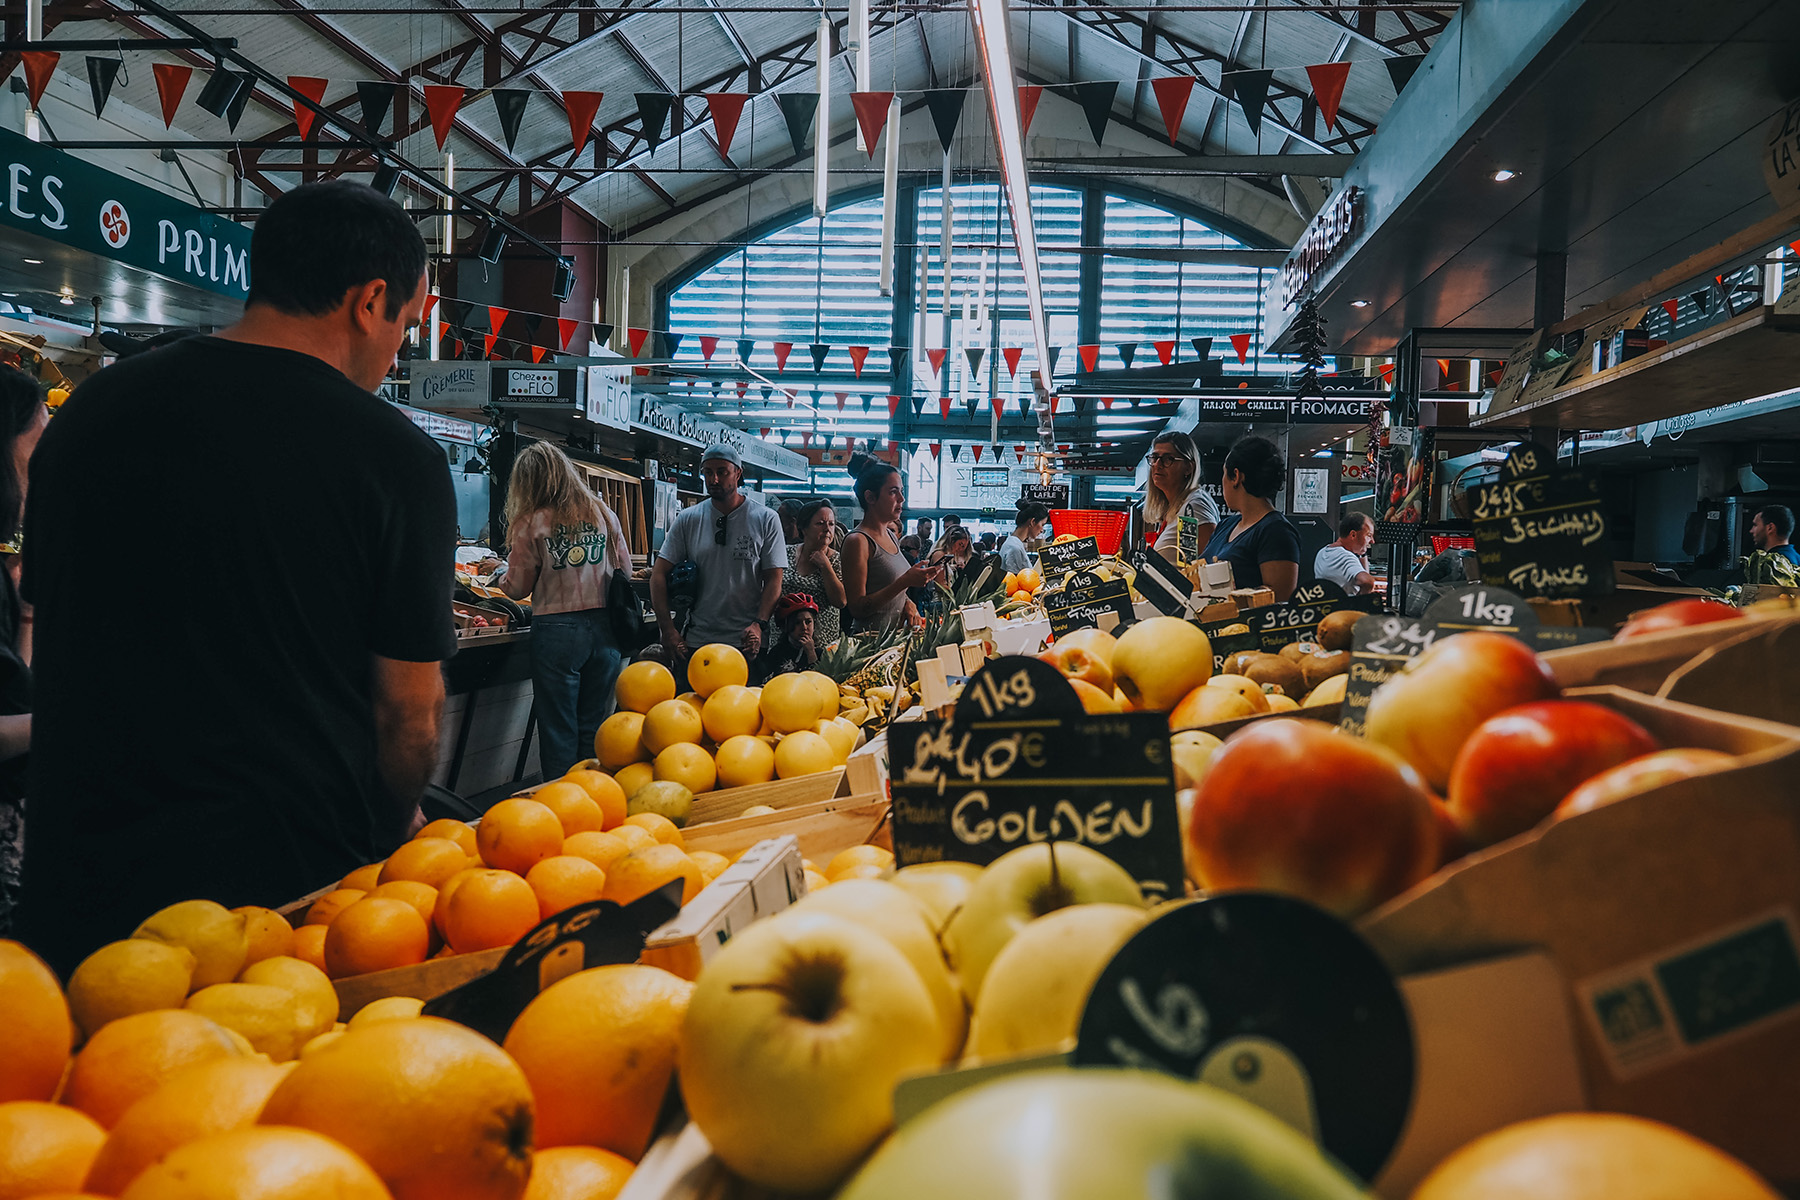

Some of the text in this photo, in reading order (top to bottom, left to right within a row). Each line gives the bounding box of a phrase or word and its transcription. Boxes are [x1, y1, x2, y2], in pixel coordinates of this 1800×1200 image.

[0, 162, 69, 231] ES
[511, 371, 536, 382] Chez
[528, 382, 555, 395] FLO
[606, 385, 630, 425] FLO
[639, 397, 678, 435] Artisan
[1202, 401, 1286, 410] MAISON CHAILLA
[1071, 575, 1092, 588] 1kg
[1295, 584, 1326, 604] 1kg
[1459, 591, 1515, 626] 1kg
[970, 669, 1037, 718] 1kg
[951, 790, 1153, 845] GOLDEN
